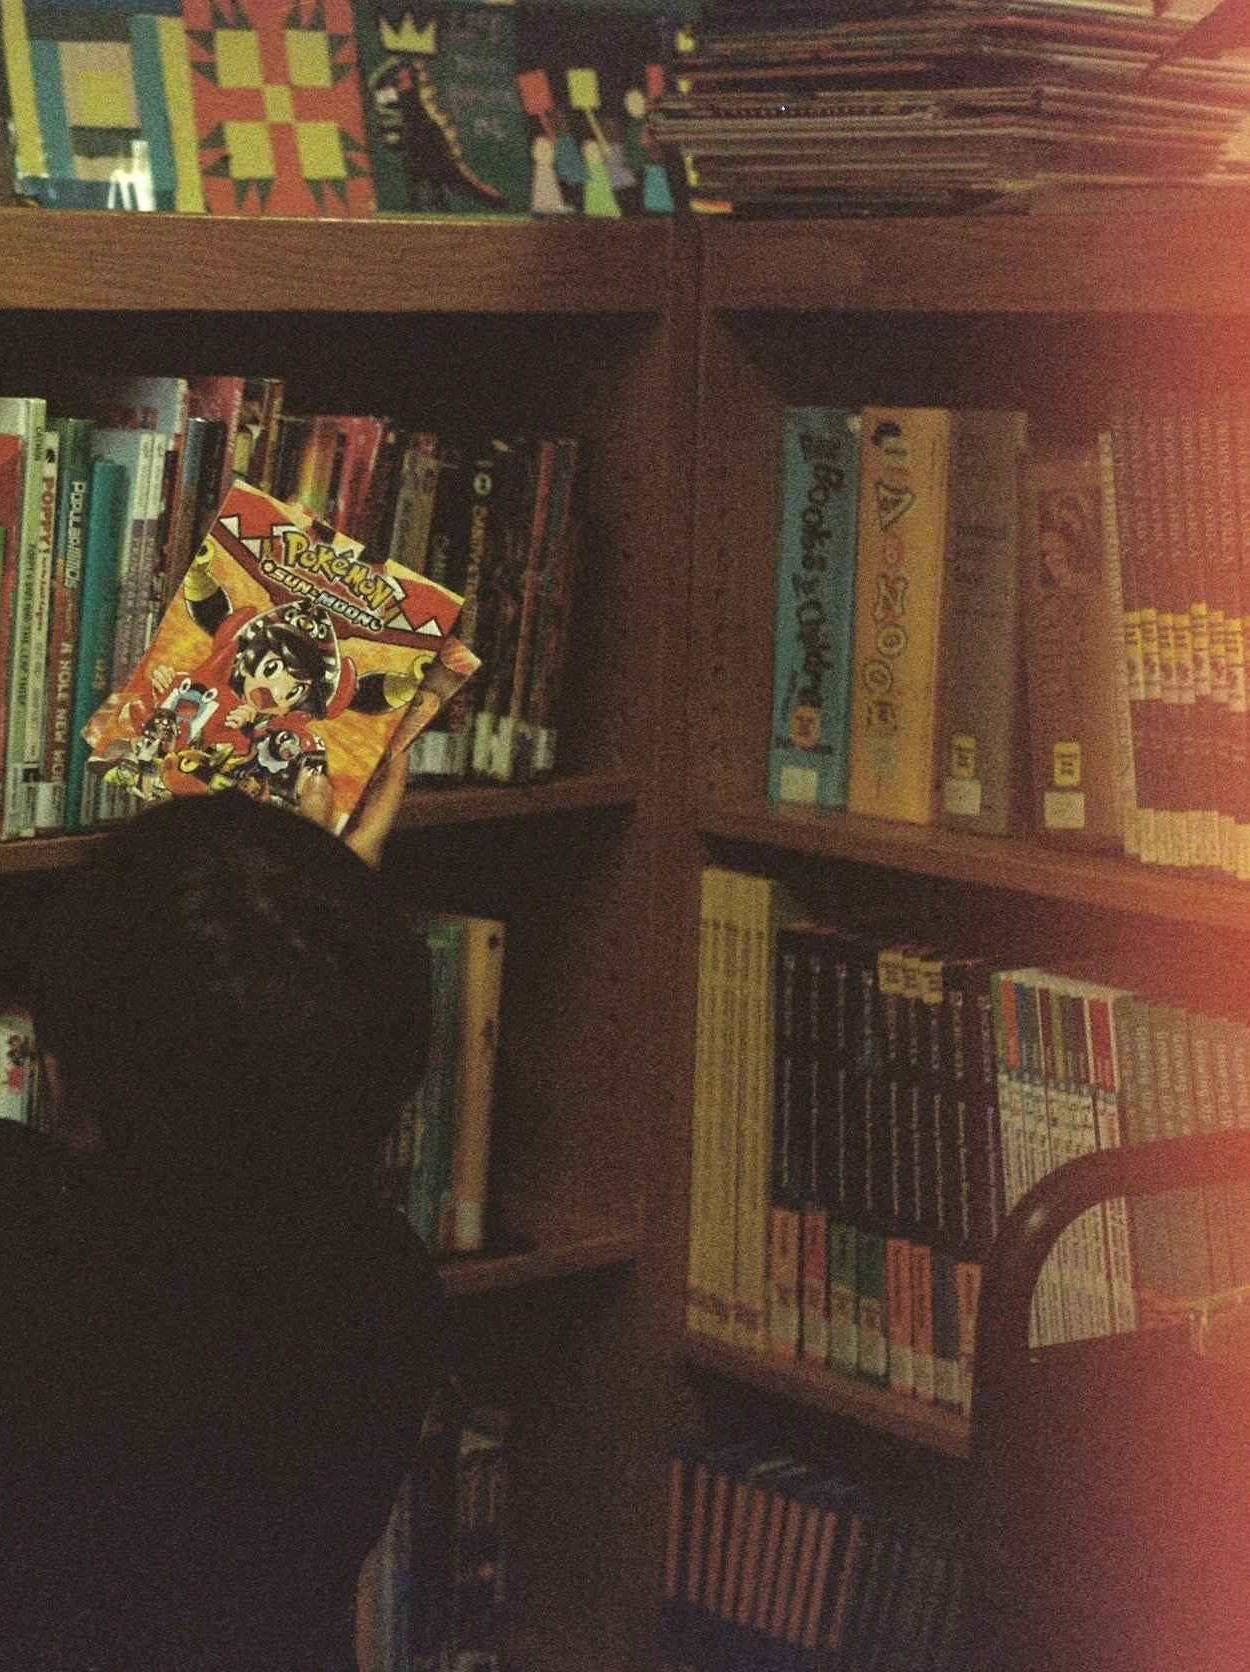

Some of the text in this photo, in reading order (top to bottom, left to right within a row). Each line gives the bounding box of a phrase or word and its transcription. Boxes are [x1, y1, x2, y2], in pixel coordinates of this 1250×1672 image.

[272, 567, 375, 630] SUN MOON
[283, 531, 395, 610] Pokémon
[52, 641, 73, 783] A HOLE NEW WOR
